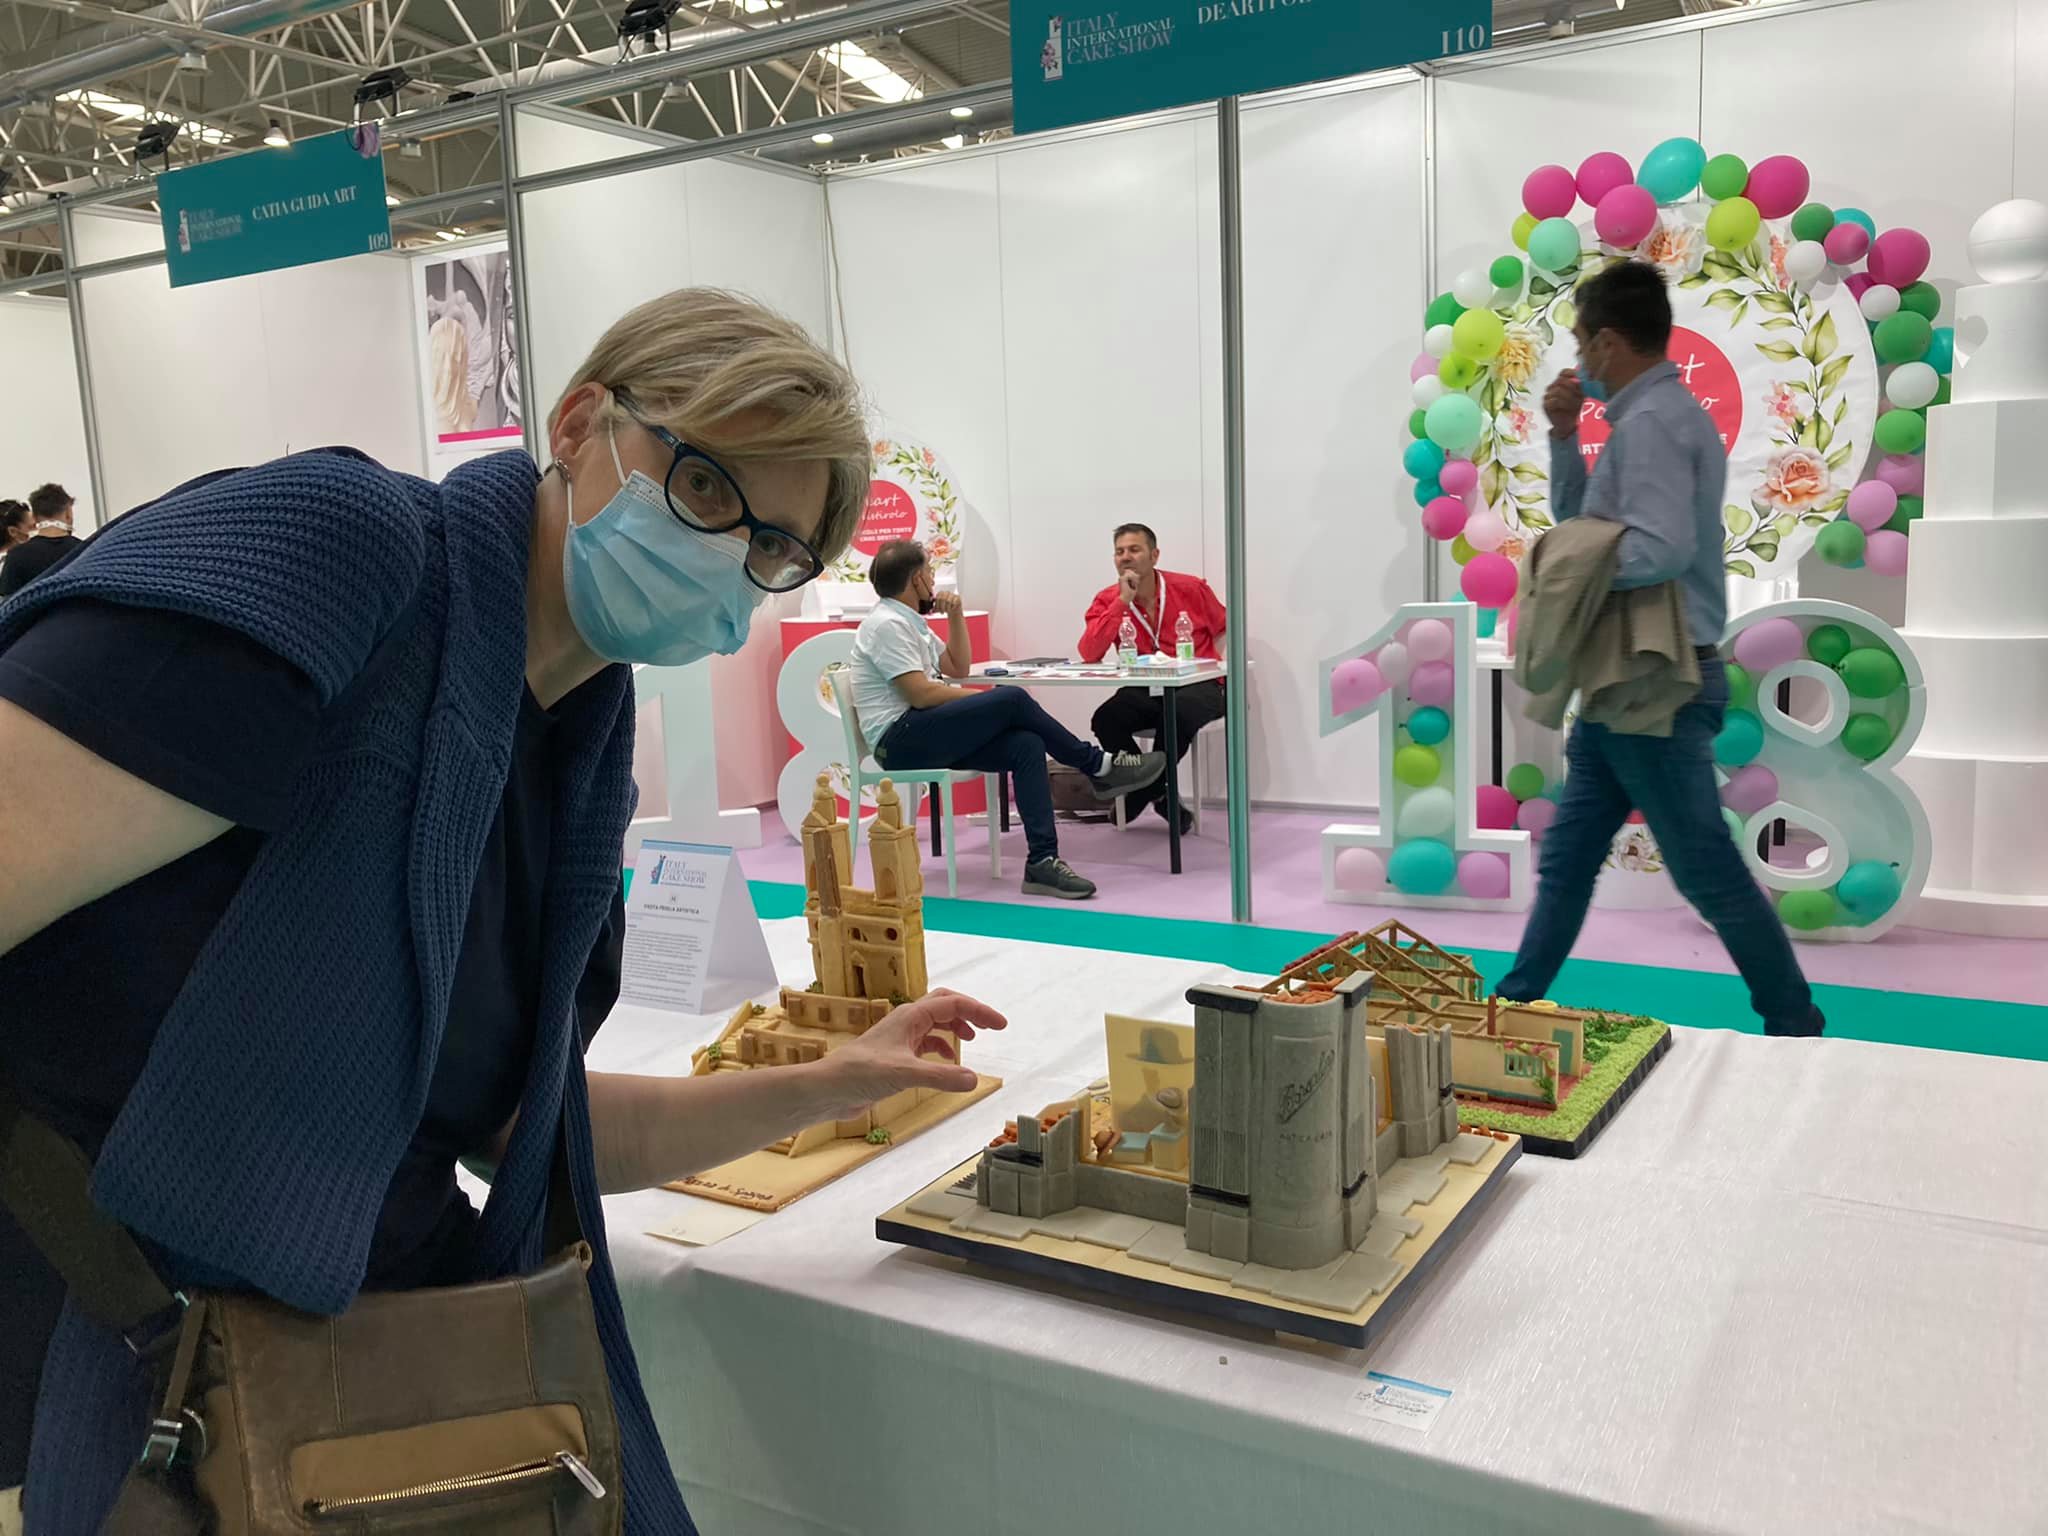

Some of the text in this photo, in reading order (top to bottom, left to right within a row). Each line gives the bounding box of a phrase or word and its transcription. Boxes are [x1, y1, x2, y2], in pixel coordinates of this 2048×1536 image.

[1067, 12, 1118, 36] ITALY
[1067, 17, 1175, 49] INTERNATIONAL
[1441, 24, 1485, 55] 110
[1067, 31, 1173, 65] CAKE SHOW
[252, 185, 357, 221] CATIA GUIDA ART
[368, 231, 389, 251] 109
